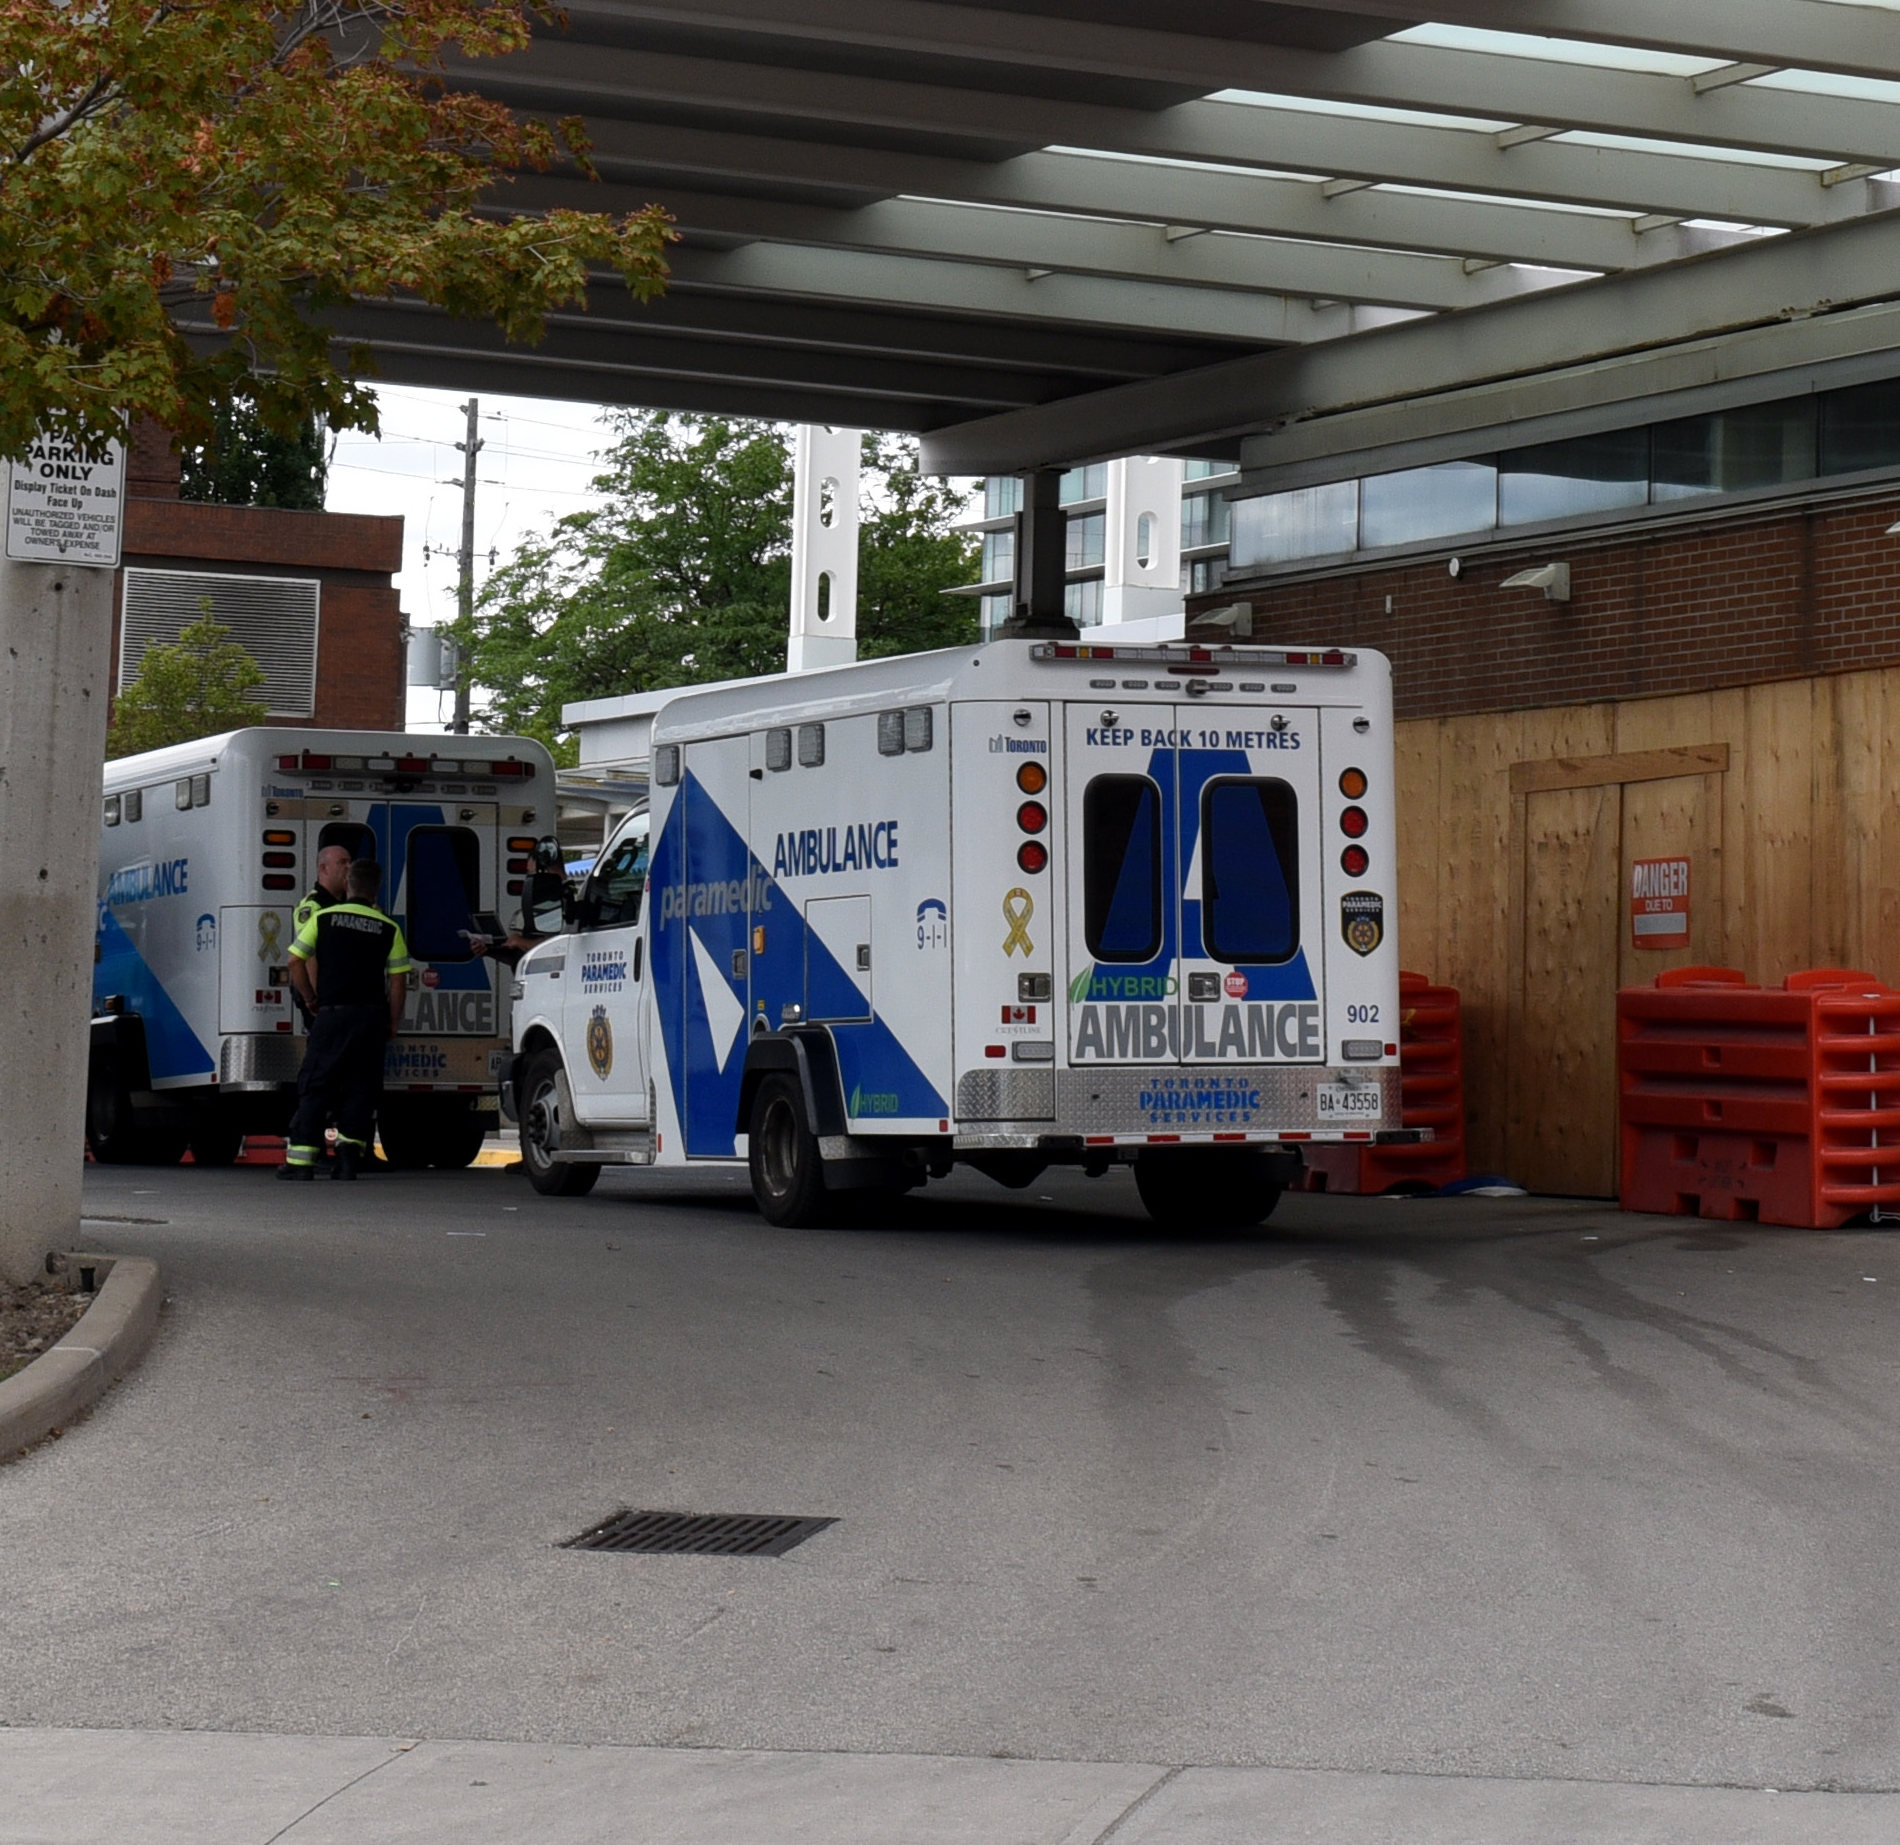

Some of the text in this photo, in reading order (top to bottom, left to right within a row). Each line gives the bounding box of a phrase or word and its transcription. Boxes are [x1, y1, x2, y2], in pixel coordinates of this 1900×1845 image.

[22, 445, 114, 466] PARKING
[40, 463, 93, 481] ONLY
[14, 480, 117, 498] Display Ticket On Dash
[47, 496, 83, 510] Face Up
[12, 508, 116, 524] UNAUTHORIZED VEHICLES
[12, 517, 31, 526] WILL
[35, 519, 45, 527] BE
[49, 520, 80, 530] TAGGED
[31, 527, 96, 540] TOWED AWAY AT
[63, 540, 100, 550] EXPENSE
[1005, 736, 1047, 753] TORONTO
[1086, 728, 1300, 750] KEEP BACK 10 METRES
[774, 820, 898, 878] AMBULANCE
[1633, 862, 1688, 898] DANGER
[660, 864, 773, 932] paramedic
[1645, 899, 1673, 912] DUE TO
[331, 913, 383, 935] PARAMEDIC
[587, 951, 624, 962] TORONTO
[581, 962, 627, 982] PARAMEDIC
[584, 982, 622, 994] SERVICES
[1090, 977, 1178, 997] HYBRID
[1227, 977, 1246, 986] STOP
[398, 992, 493, 1032] LANCE
[1347, 1005, 1379, 1023] 902
[1075, 1004, 1320, 1059] AMBULANCE
[387, 1053, 446, 1068] AMEDIC
[1150, 1078, 1249, 1089] TORONTO
[860, 1094, 898, 1113] HYBRID
[1140, 1090, 1260, 1110] PARAMEDIC
[1150, 1111, 1251, 1123] SERVICES
